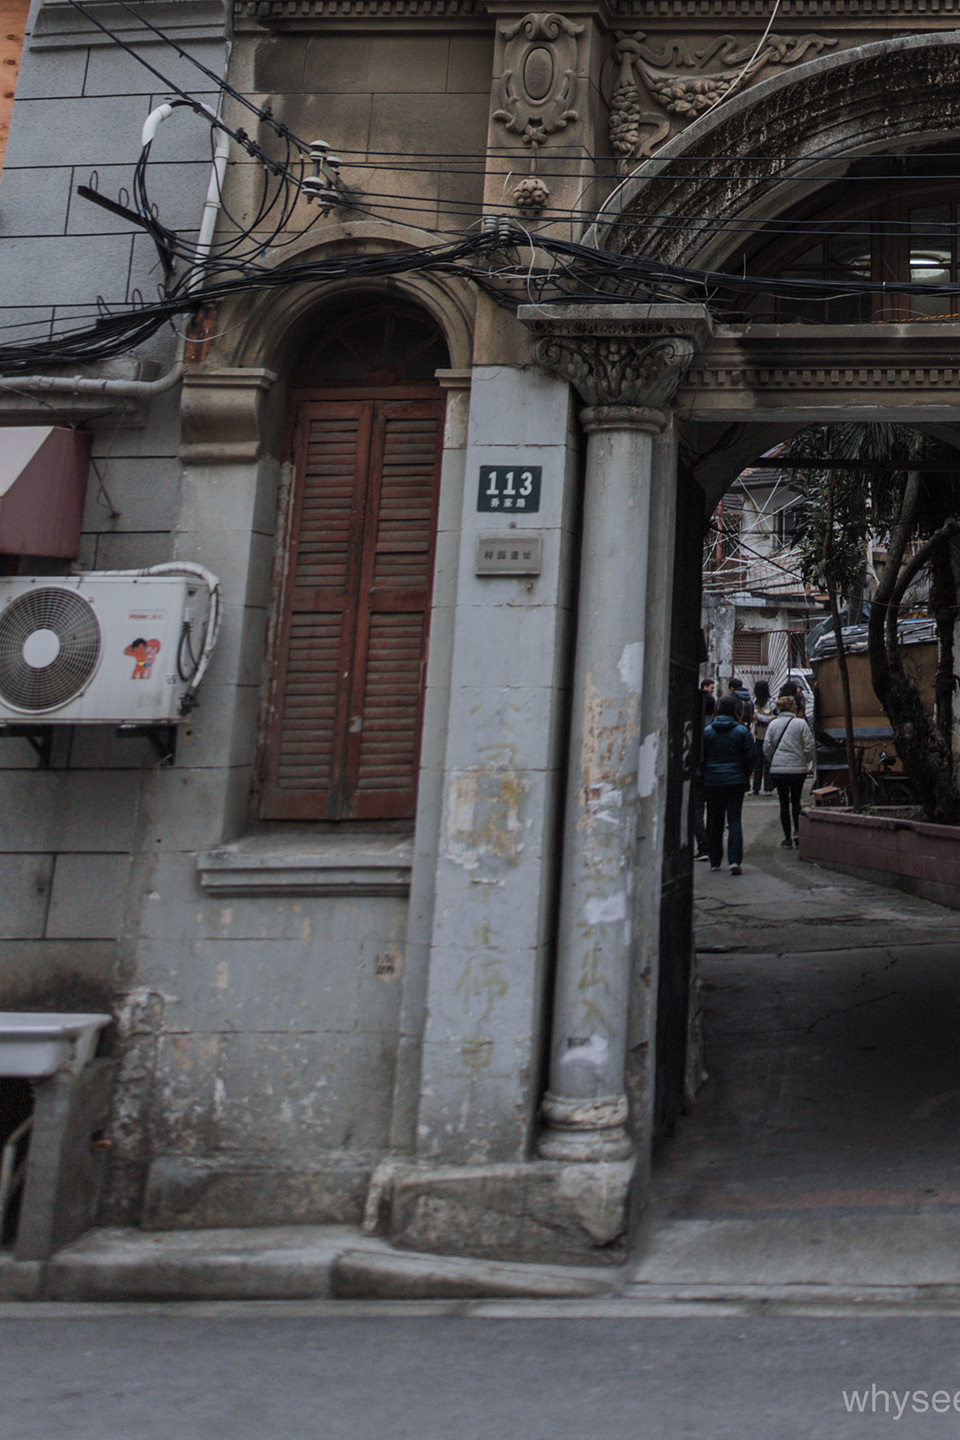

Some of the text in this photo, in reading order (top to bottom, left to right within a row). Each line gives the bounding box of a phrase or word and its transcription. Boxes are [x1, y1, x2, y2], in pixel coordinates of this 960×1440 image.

[485, 471, 533, 496] 113
[490, 497, 526, 508] 乔家路
